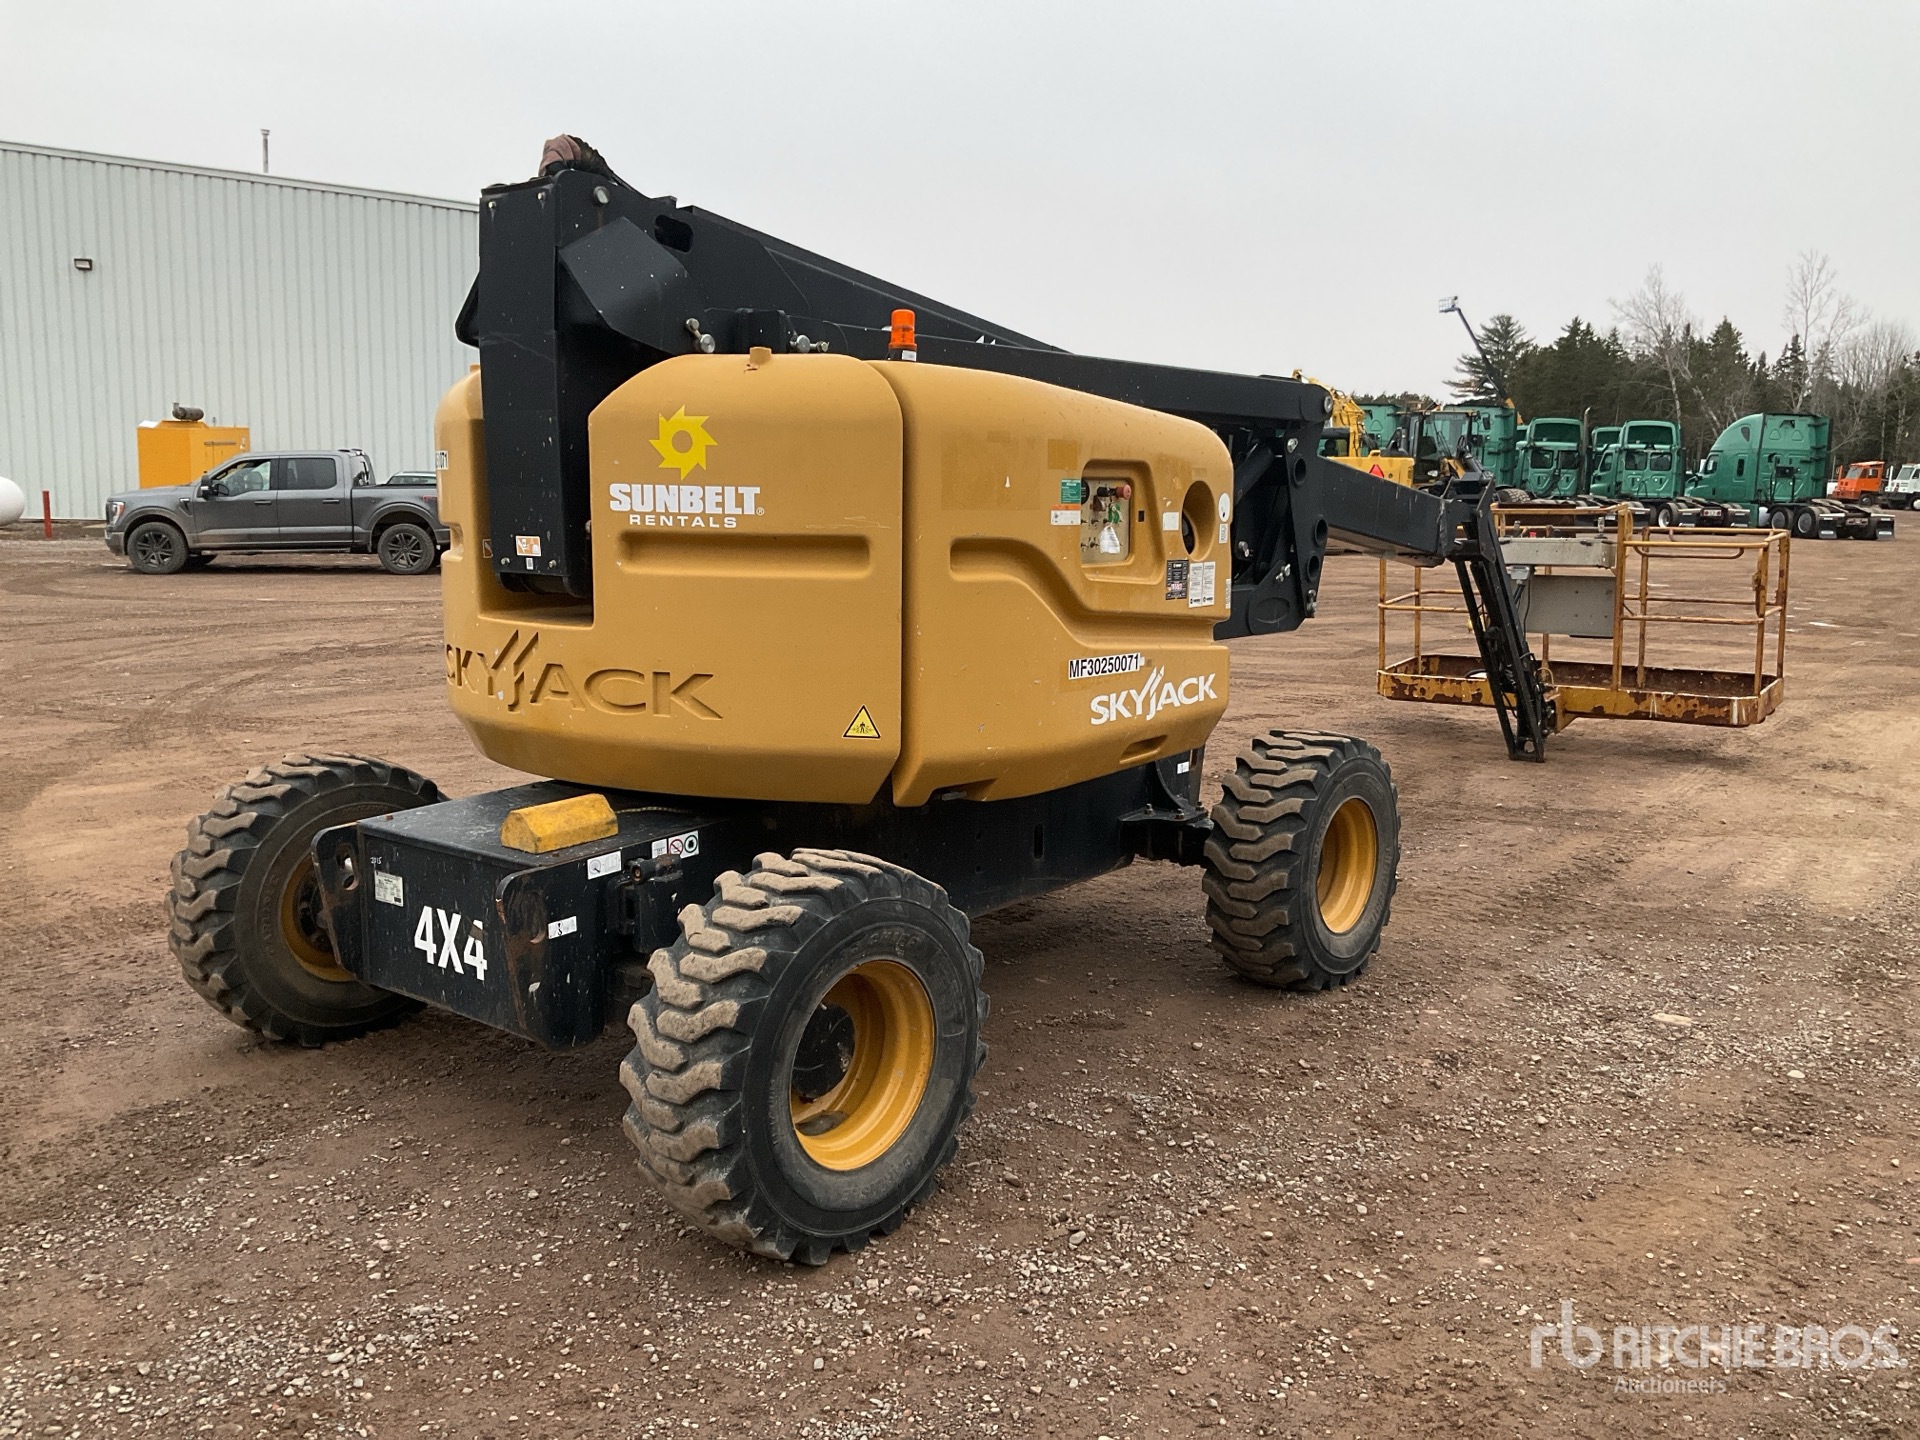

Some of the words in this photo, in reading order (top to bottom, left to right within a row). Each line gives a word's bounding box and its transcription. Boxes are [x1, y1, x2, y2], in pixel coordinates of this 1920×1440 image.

[609, 483, 761, 515] SUNBELT
[629, 514, 737, 528] RENTALS
[446, 629, 723, 720] SKYJACK
[1069, 654, 1139, 678] MF30250071
[1090, 666, 1217, 725] SKYJACK
[413, 905, 488, 981] 4X4
